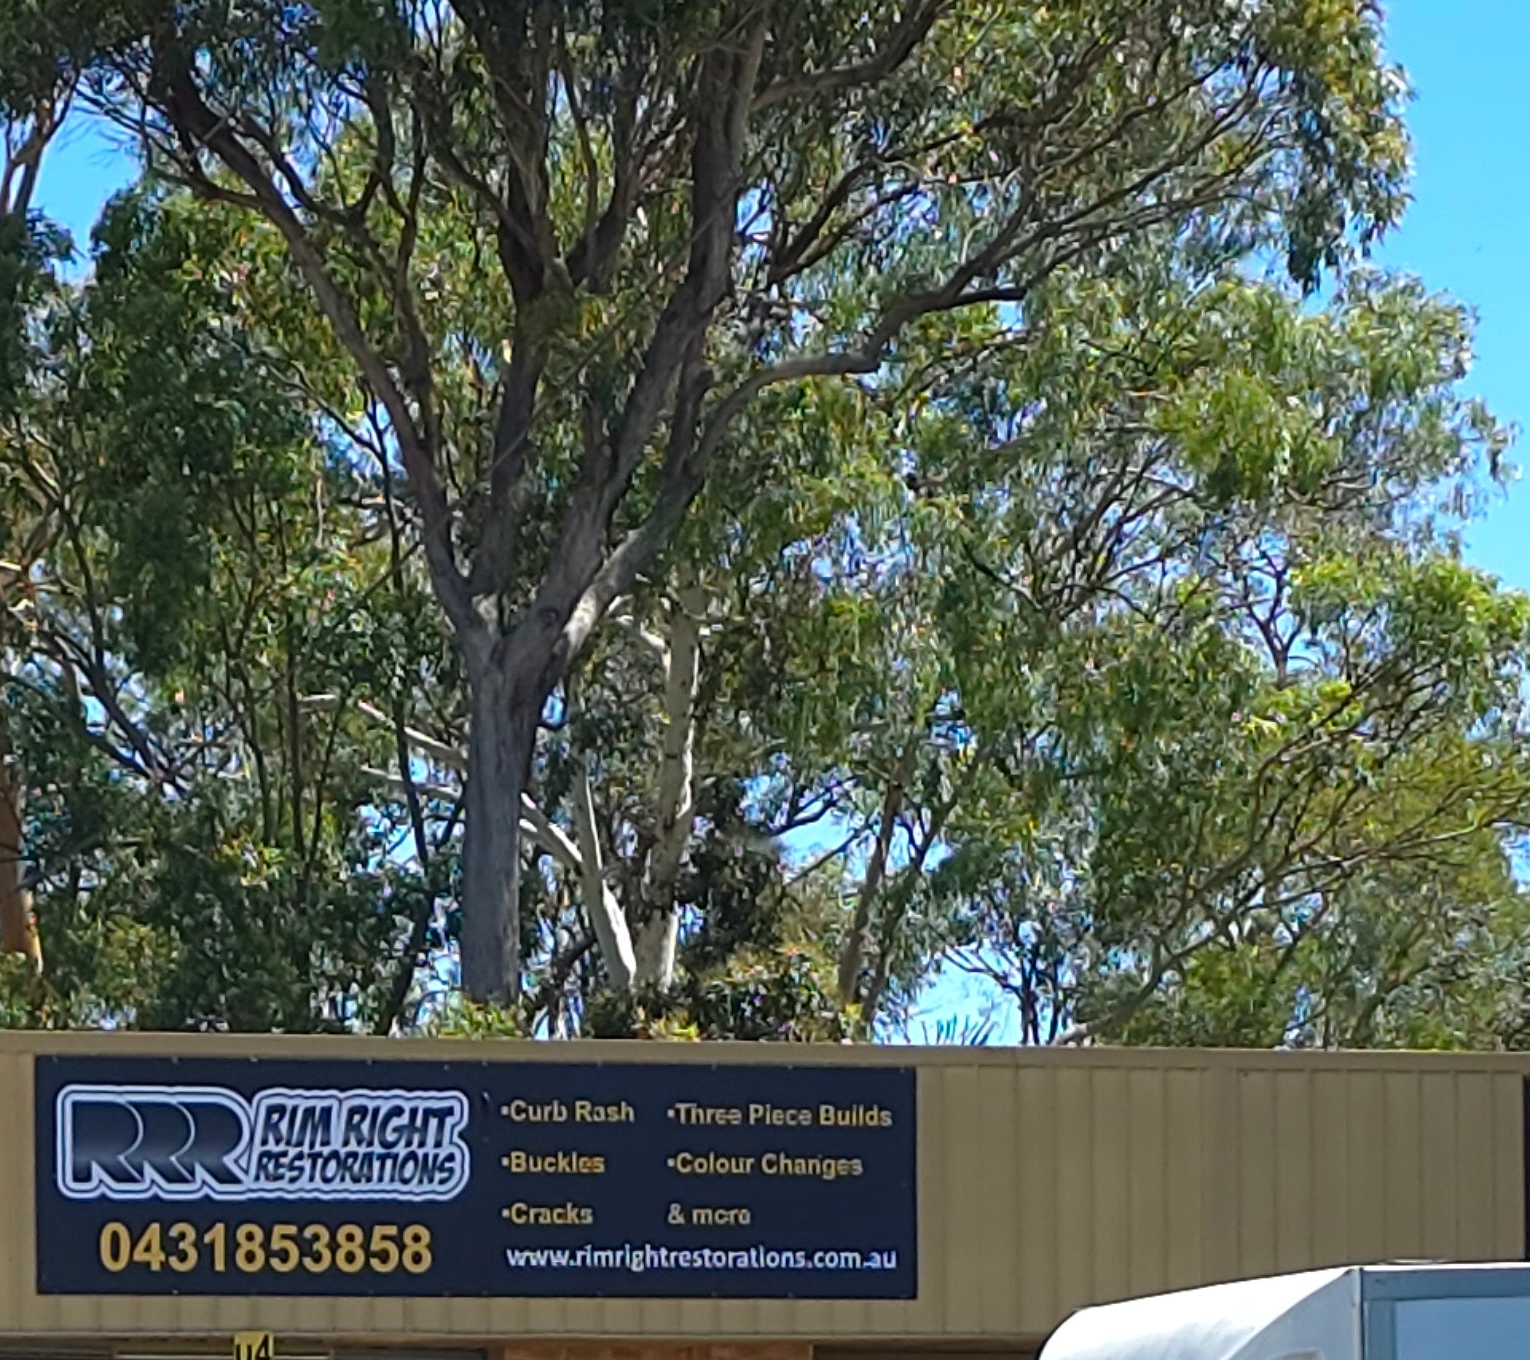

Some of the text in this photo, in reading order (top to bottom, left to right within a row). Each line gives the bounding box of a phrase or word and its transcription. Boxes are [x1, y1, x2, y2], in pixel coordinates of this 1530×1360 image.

[260, 1103, 456, 1149] RIM RIGHT
[575, 1100, 635, 1123] Rash
[749, 1104, 812, 1126] Piece
[820, 1104, 893, 1127] Builds
[70, 1099, 247, 1185] RRR
[254, 1150, 456, 1187] RESTORATIONS
[761, 1153, 863, 1180] Changes
[668, 1203, 752, 1226] & more
[100, 1221, 432, 1274] 0431853858
[506, 1243, 897, 1272] www.rimrightrestorations.com.au
